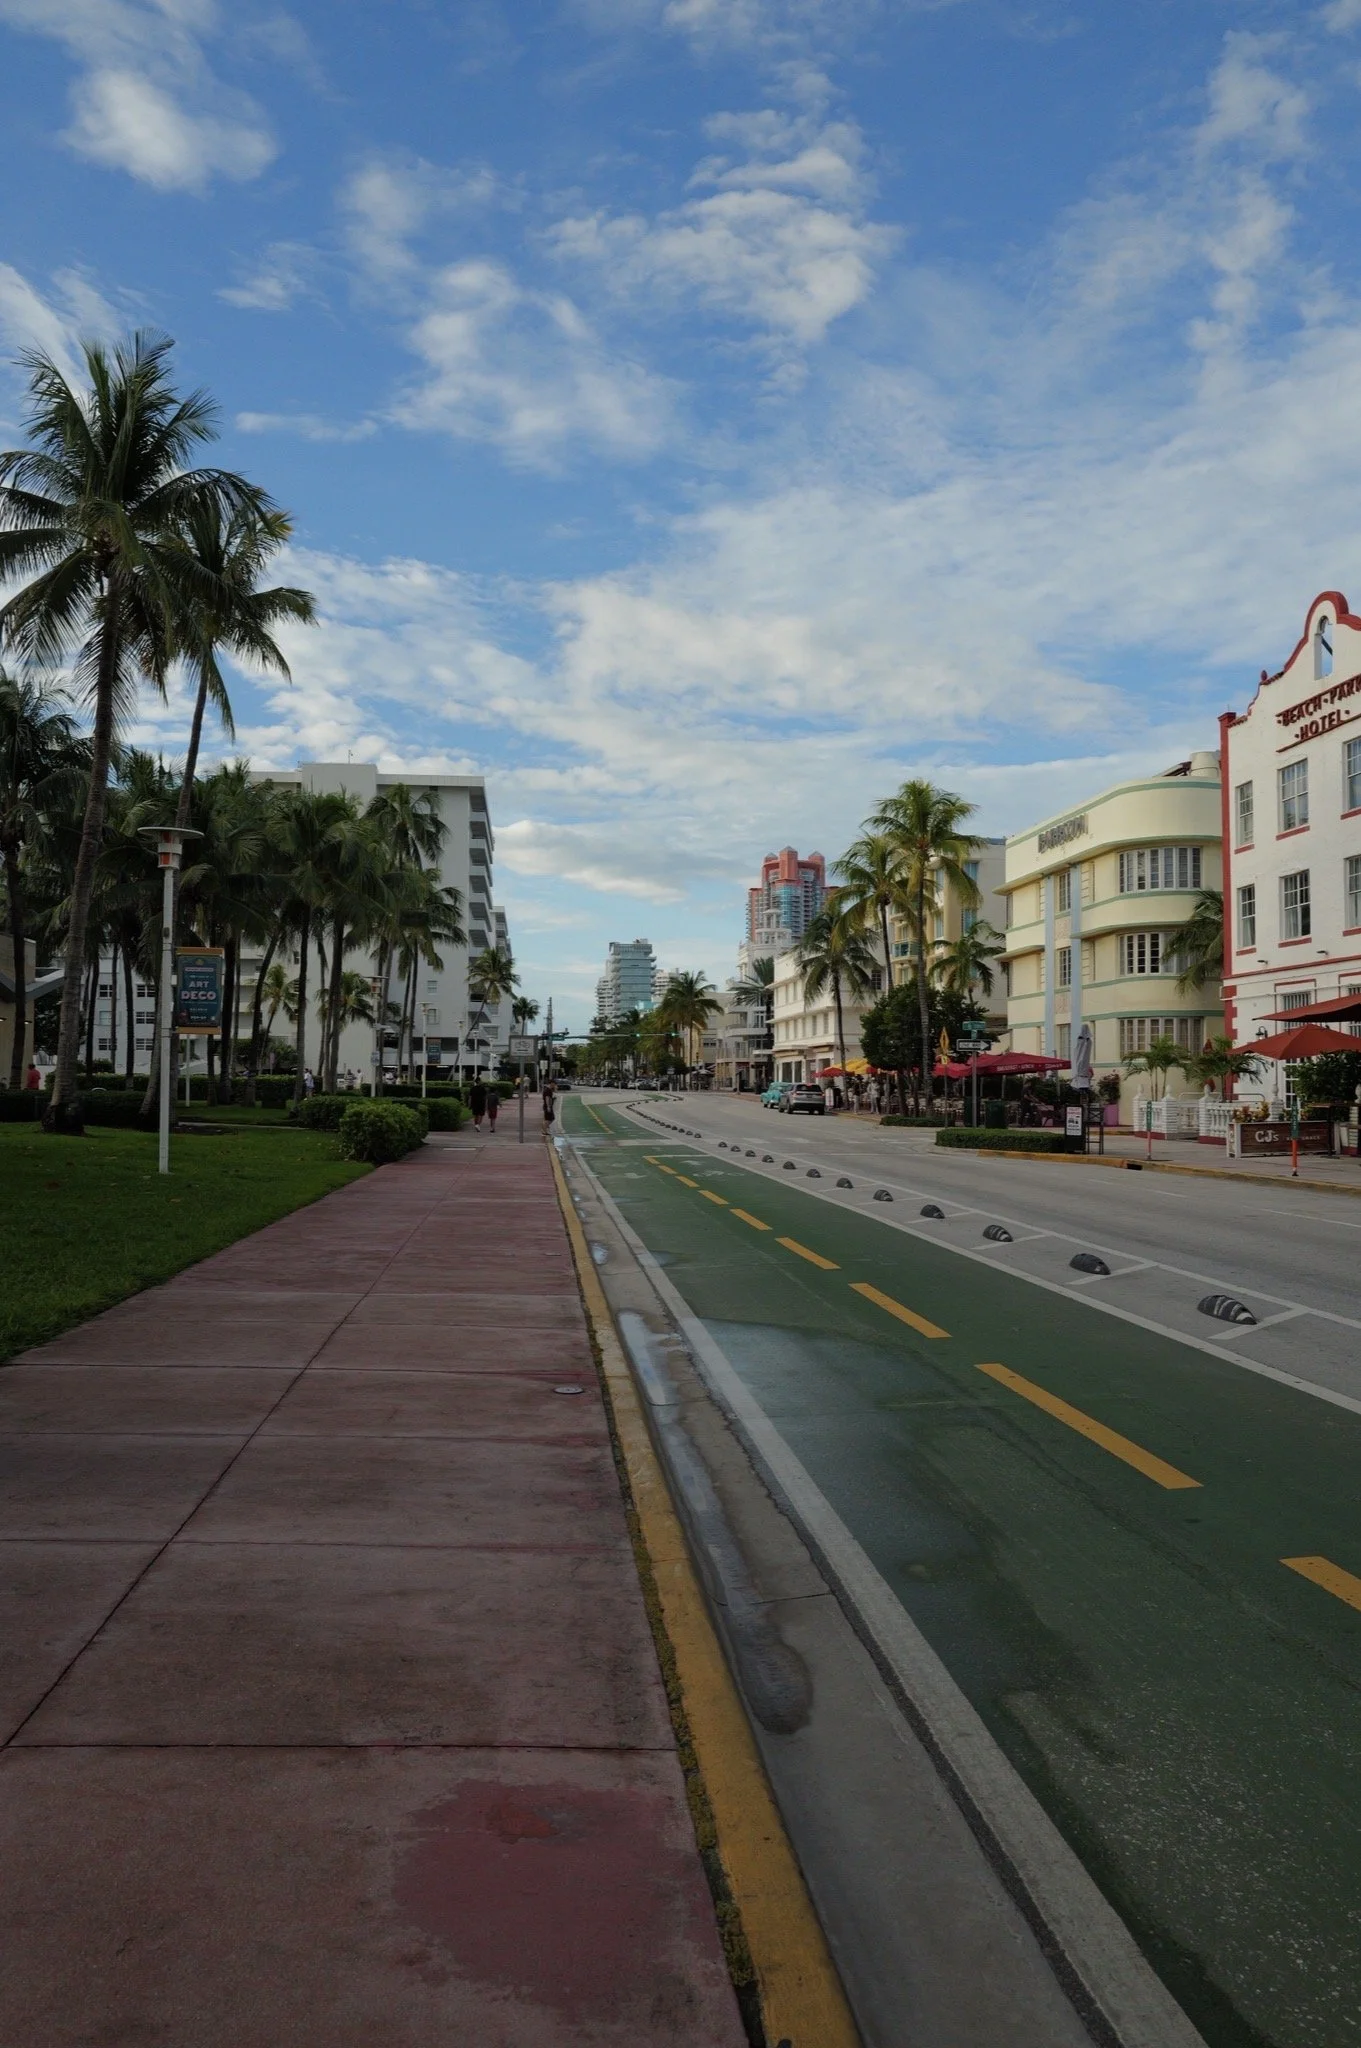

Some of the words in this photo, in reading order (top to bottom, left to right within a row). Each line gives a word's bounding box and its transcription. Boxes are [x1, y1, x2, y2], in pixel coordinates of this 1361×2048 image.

[1282, 695, 1322, 727] BEACH
[1300, 709, 1342, 740] HOTEL
[181, 991, 216, 1000] DECO
